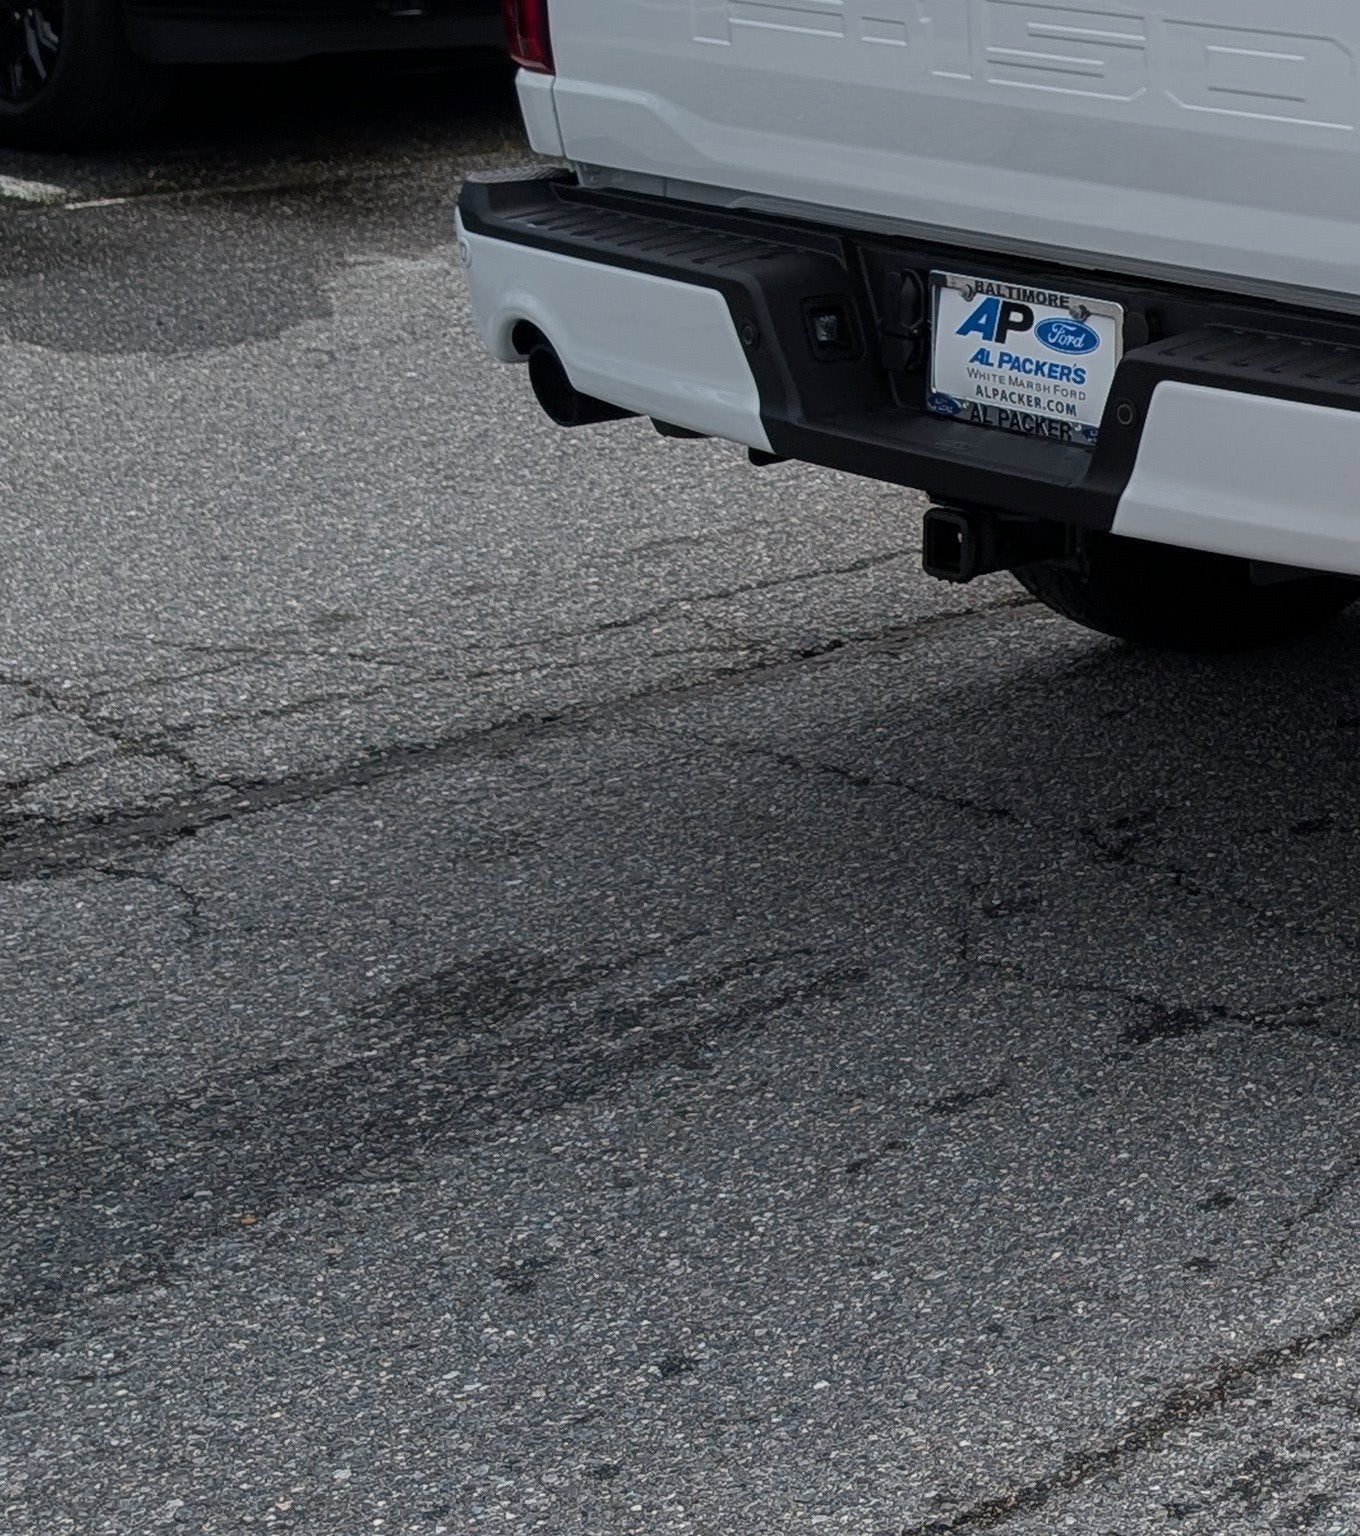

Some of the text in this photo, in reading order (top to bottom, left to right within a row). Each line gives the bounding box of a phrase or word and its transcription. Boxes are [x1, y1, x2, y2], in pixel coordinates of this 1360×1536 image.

[974, 280, 1070, 308] BALTIMORE
[956, 297, 1034, 344] AP
[1047, 322, 1085, 349] Ford
[969, 347, 994, 367] AL
[976, 385, 1078, 417] ALPACKER.COM
[970, 402, 994, 425] AL
[998, 409, 1072, 442] PACKER
